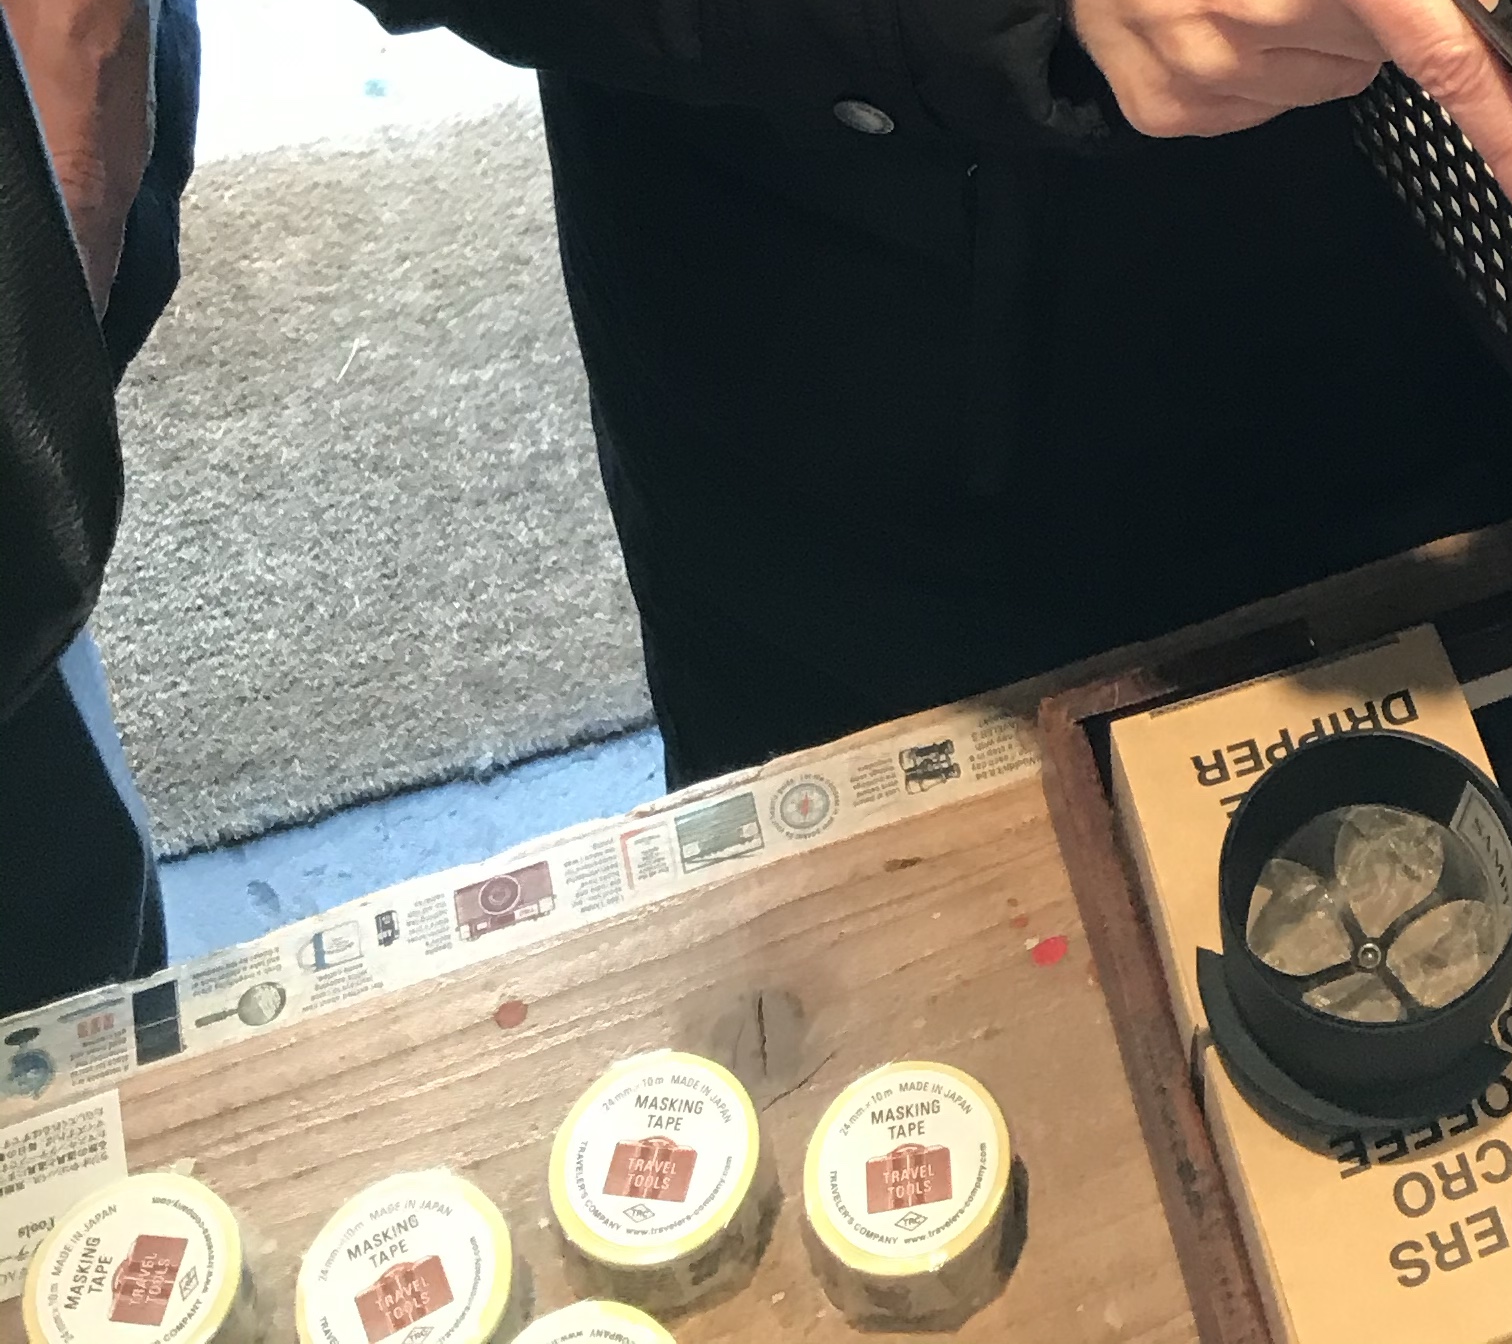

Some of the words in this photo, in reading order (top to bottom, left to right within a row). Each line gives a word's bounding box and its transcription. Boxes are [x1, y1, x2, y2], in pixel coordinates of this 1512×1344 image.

[634, 1095, 704, 1114] MASKING
[671, 1075, 700, 1090] MADE
[700, 1085, 711, 1097] IN
[710, 1094, 732, 1124] JAPAN
[871, 1099, 941, 1125] MASKING
[899, 1082, 929, 1092] MADE
[931, 1083, 943, 1095] IN
[944, 1089, 973, 1115] JAPAN
[647, 1115, 683, 1131] TAPE
[888, 1120, 925, 1140] TAPE
[628, 1158, 677, 1175] TRAVEL
[628, 1174, 670, 1190] TOOLS
[883, 1164, 935, 1184] TRAVEL
[830, 1170, 854, 1225] TRAVELER'S
[854, 1223, 898, 1244] COMPANY
[904, 1142, 986, 1244] www.travelers-company.com
[888, 1180, 932, 1199] TOOLS
[369, 1202, 401, 1221] MADE
[404, 1199, 416, 1209] IN
[419, 1200, 453, 1216] JAPAN
[585, 1199, 623, 1231] COMPANY
[52, 1247, 72, 1276] MADE
[70, 1233, 83, 1247] IN
[83, 1204, 117, 1233] JAPAN
[347, 1214, 419, 1261] MASKING
[369, 1239, 409, 1268] TAPE
[64, 1237, 101, 1310] MASKING
[88, 1256, 113, 1294] TAPE
[129, 1252, 158, 1306] TRAVEL
[145, 1258, 170, 1304] TOOLS
[375, 1276, 430, 1311] TRAVEL
[385, 1292, 430, 1320] TOOLS
[163, 1299, 203, 1341] COMPANY
